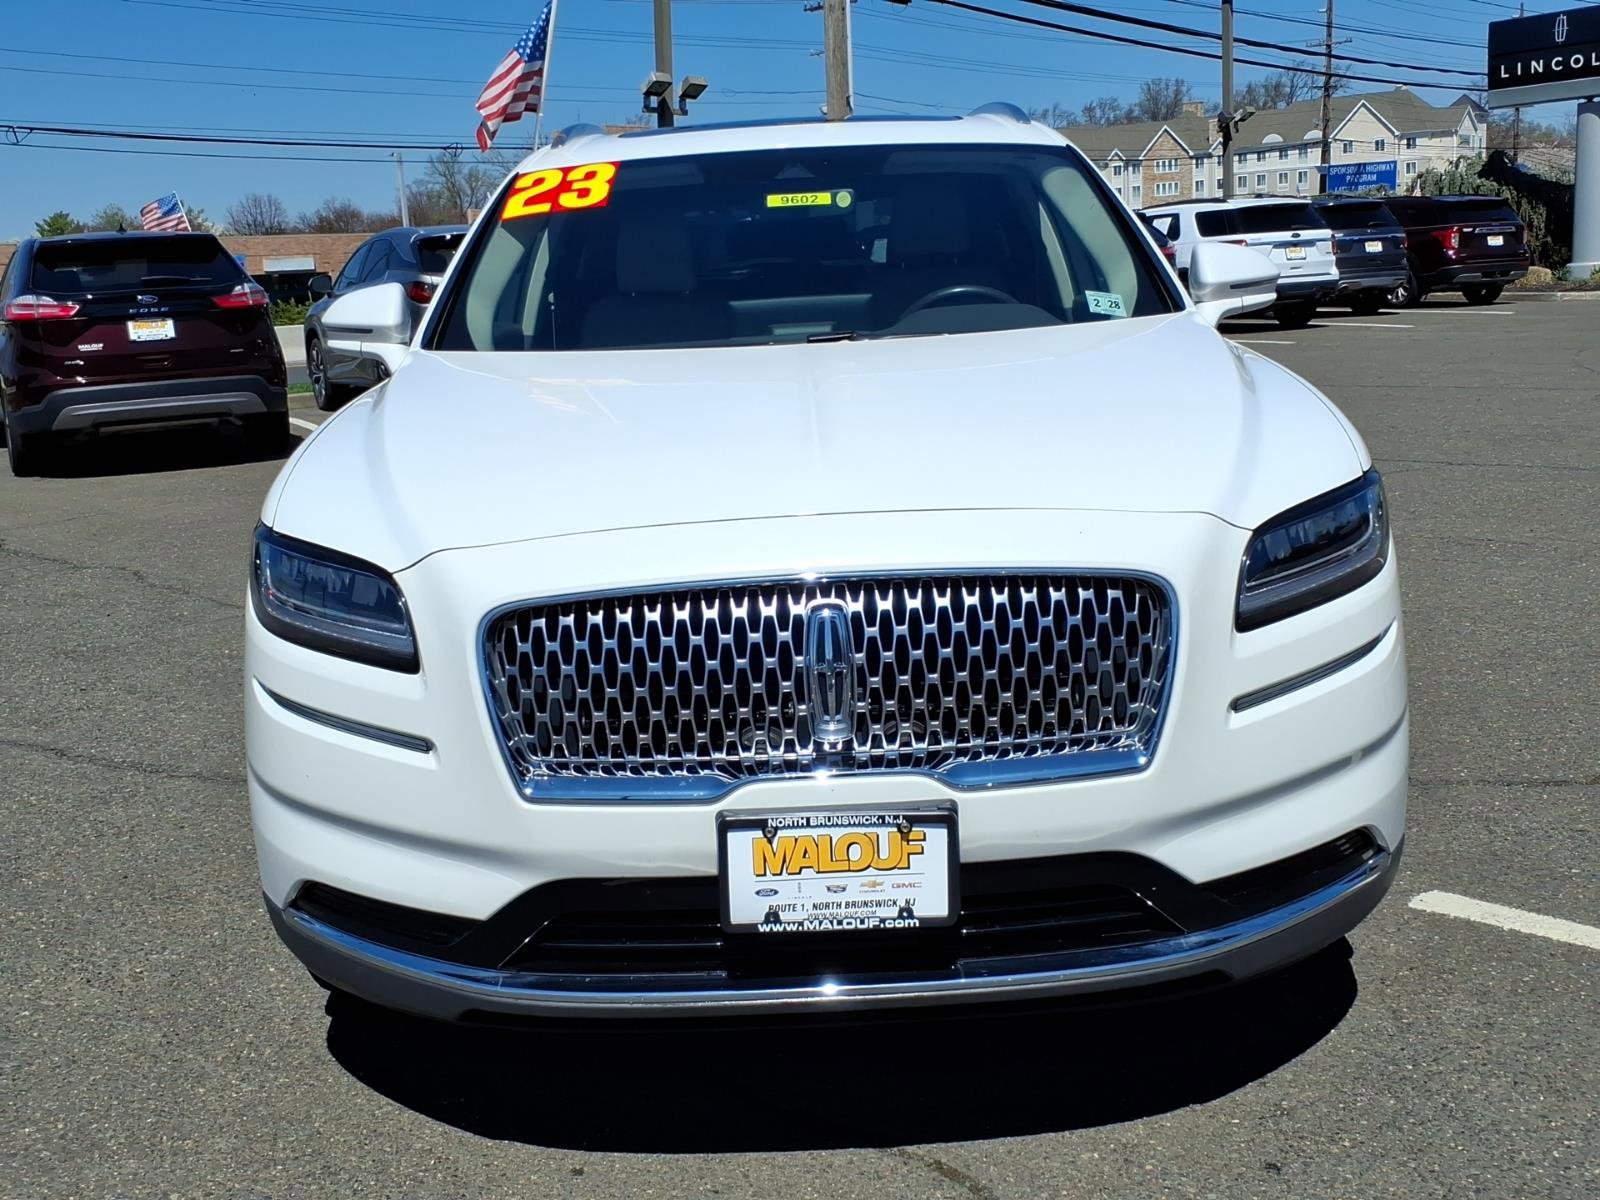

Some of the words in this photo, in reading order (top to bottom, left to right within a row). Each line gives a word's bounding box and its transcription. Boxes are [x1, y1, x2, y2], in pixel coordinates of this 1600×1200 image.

[1366, 163, 1394, 172] HIGHWAY
[502, 163, 615, 219] 23
[781, 195, 818, 204] 9602
[1093, 298, 1101, 308] 2
[1107, 299, 1120, 310] 28
[768, 817, 806, 828] NORTH
[752, 830, 926, 877] MALOUF
[757, 888, 778, 897] Ford
[768, 903, 798, 913] ROUTE
[812, 901, 842, 911] NORTH
[904, 898, 916, 907] NJ
[757, 917, 920, 932] www.MALOUF.com
